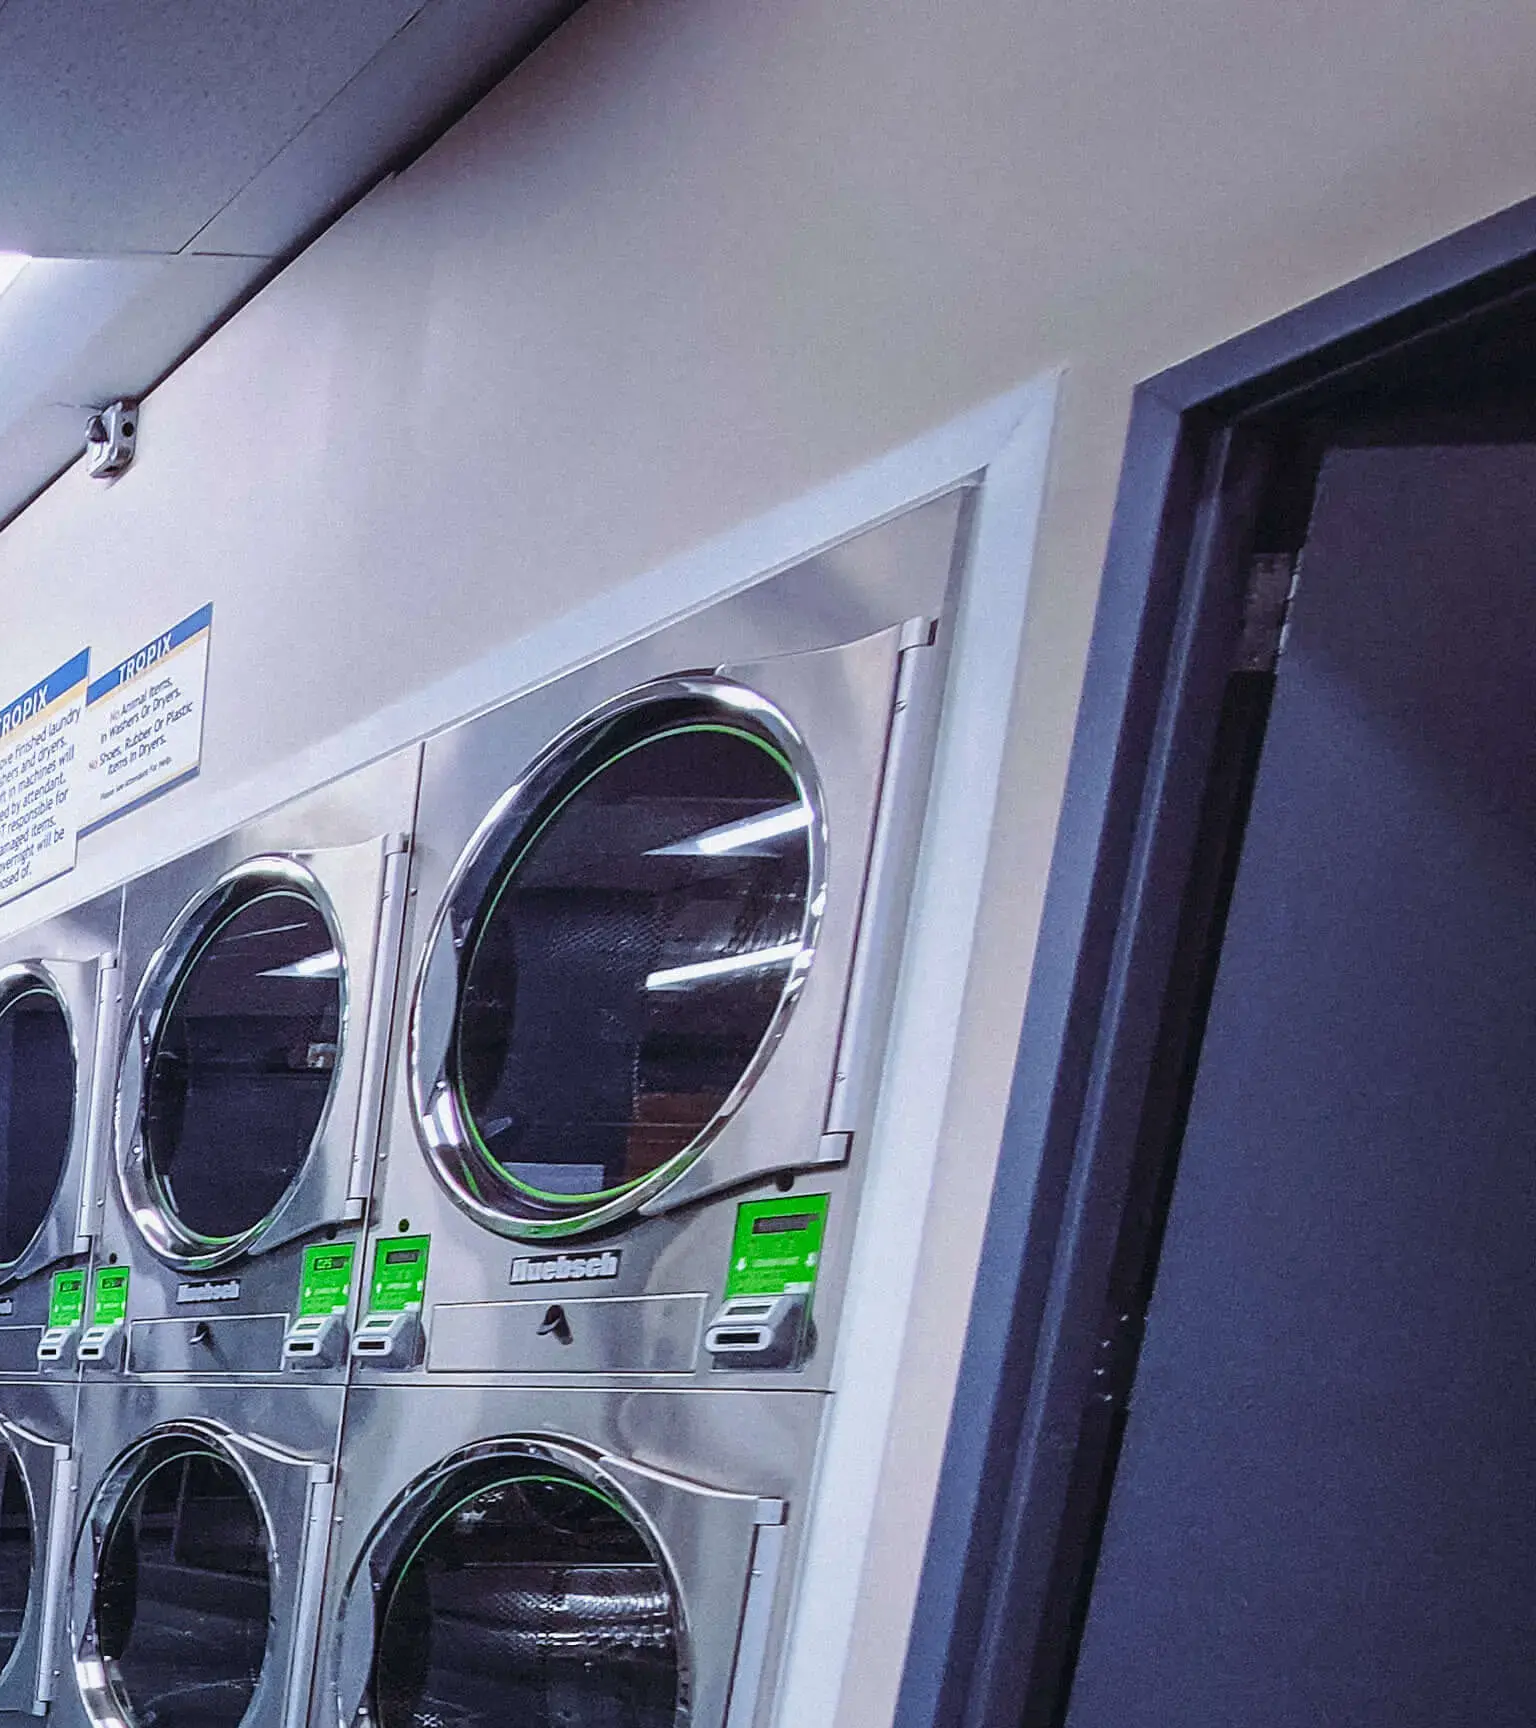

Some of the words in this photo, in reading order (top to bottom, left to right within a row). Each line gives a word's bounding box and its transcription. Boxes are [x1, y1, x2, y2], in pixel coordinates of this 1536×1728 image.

[118, 631, 172, 684] TROPIX
[49, 705, 81, 737] laundry
[166, 702, 193, 726] Plastic
[18, 759, 57, 793] machines
[59, 743, 74, 767] will
[20, 751, 36, 774] and
[55, 788, 69, 806] for
[53, 827, 65, 844] be
